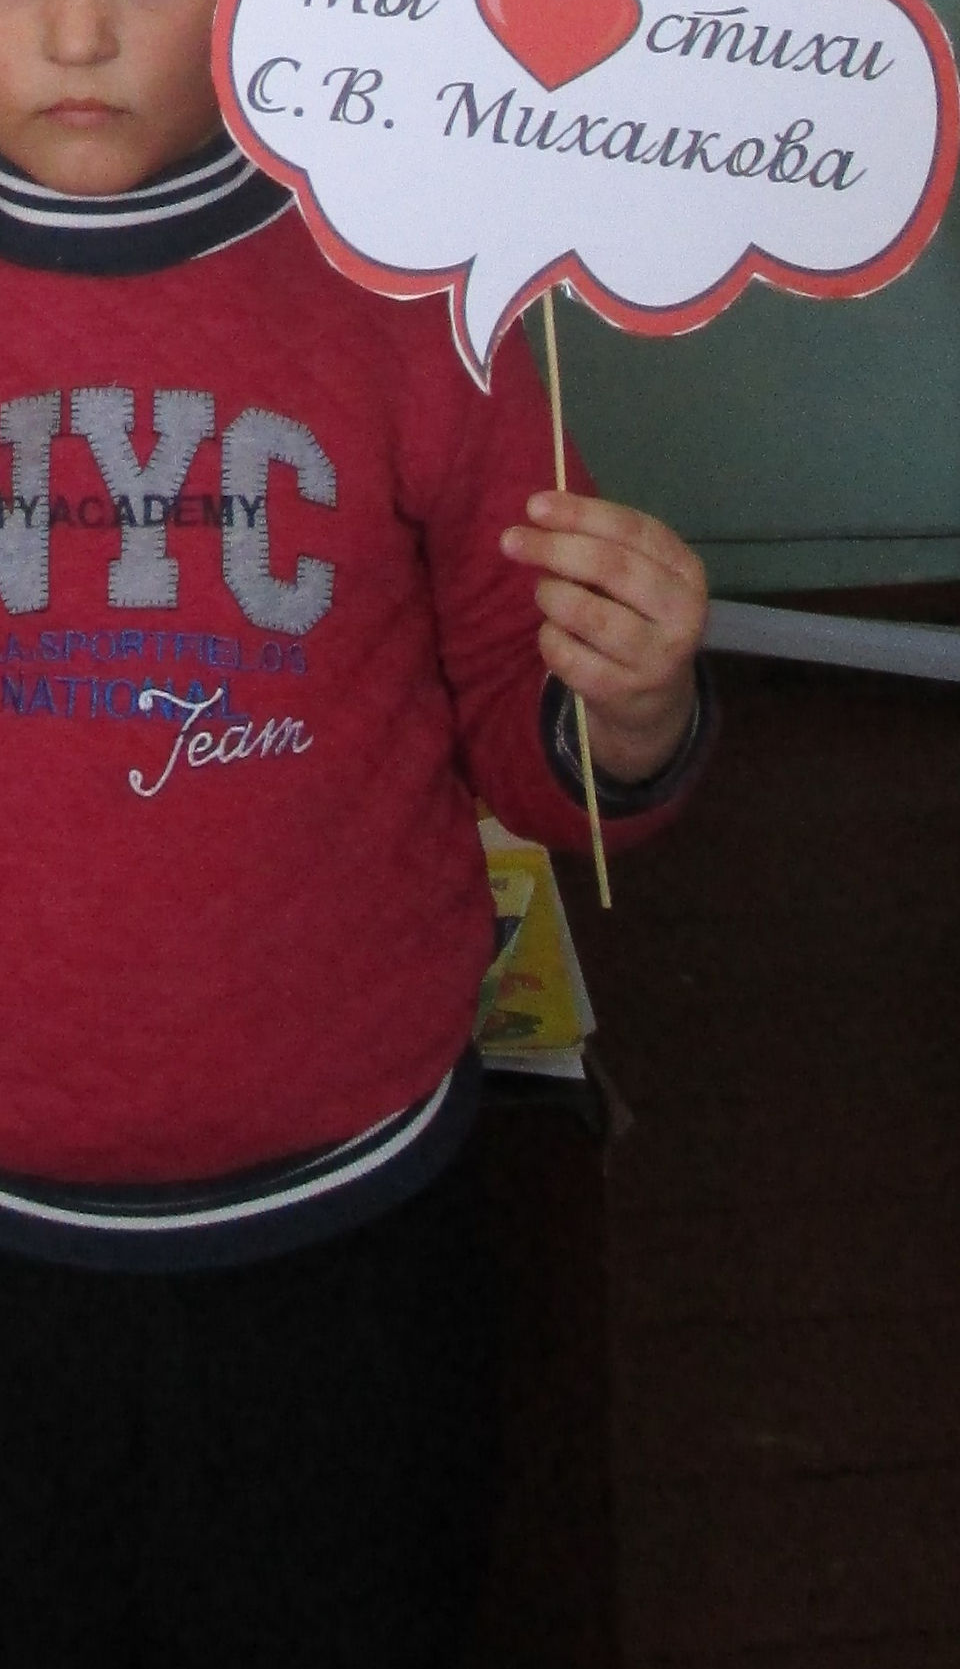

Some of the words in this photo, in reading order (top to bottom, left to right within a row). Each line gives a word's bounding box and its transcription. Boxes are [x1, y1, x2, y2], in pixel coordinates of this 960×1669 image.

[645, 6, 895, 82] стихи
[246, 56, 307, 118] С.
[322, 65, 396, 130] В.
[435, 80, 869, 192] Михалкова
[49, 495, 266, 530] ACADEMY
[1, 675, 250, 722] NATIONAL
[128, 687, 314, 798] Team
